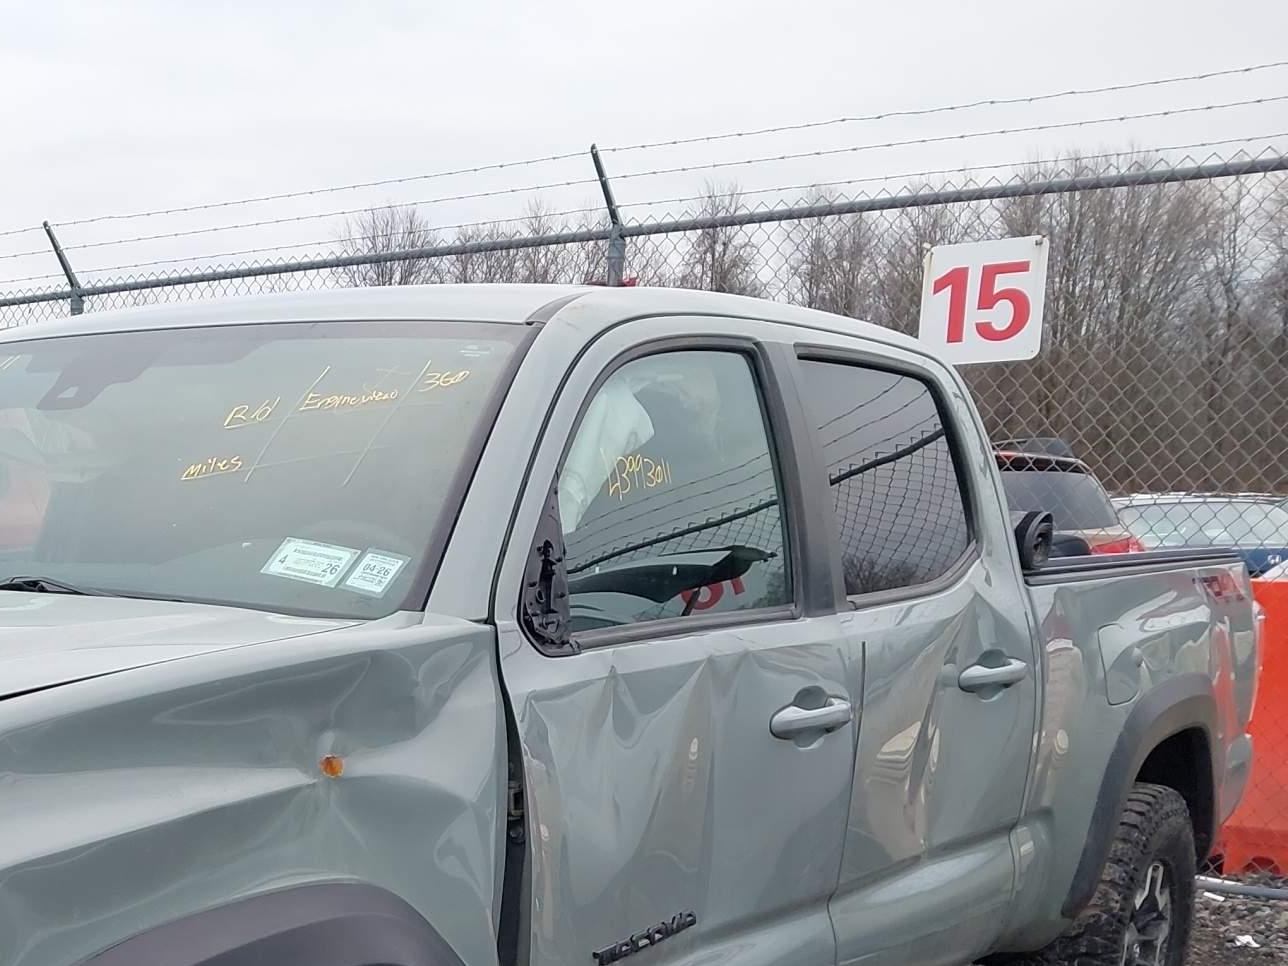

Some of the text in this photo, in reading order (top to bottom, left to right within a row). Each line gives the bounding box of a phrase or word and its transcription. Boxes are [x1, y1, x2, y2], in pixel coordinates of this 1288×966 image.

[932, 260, 1031, 343] 15
[599, 446, 672, 502] 43993011
[320, 562, 341, 577] 26
